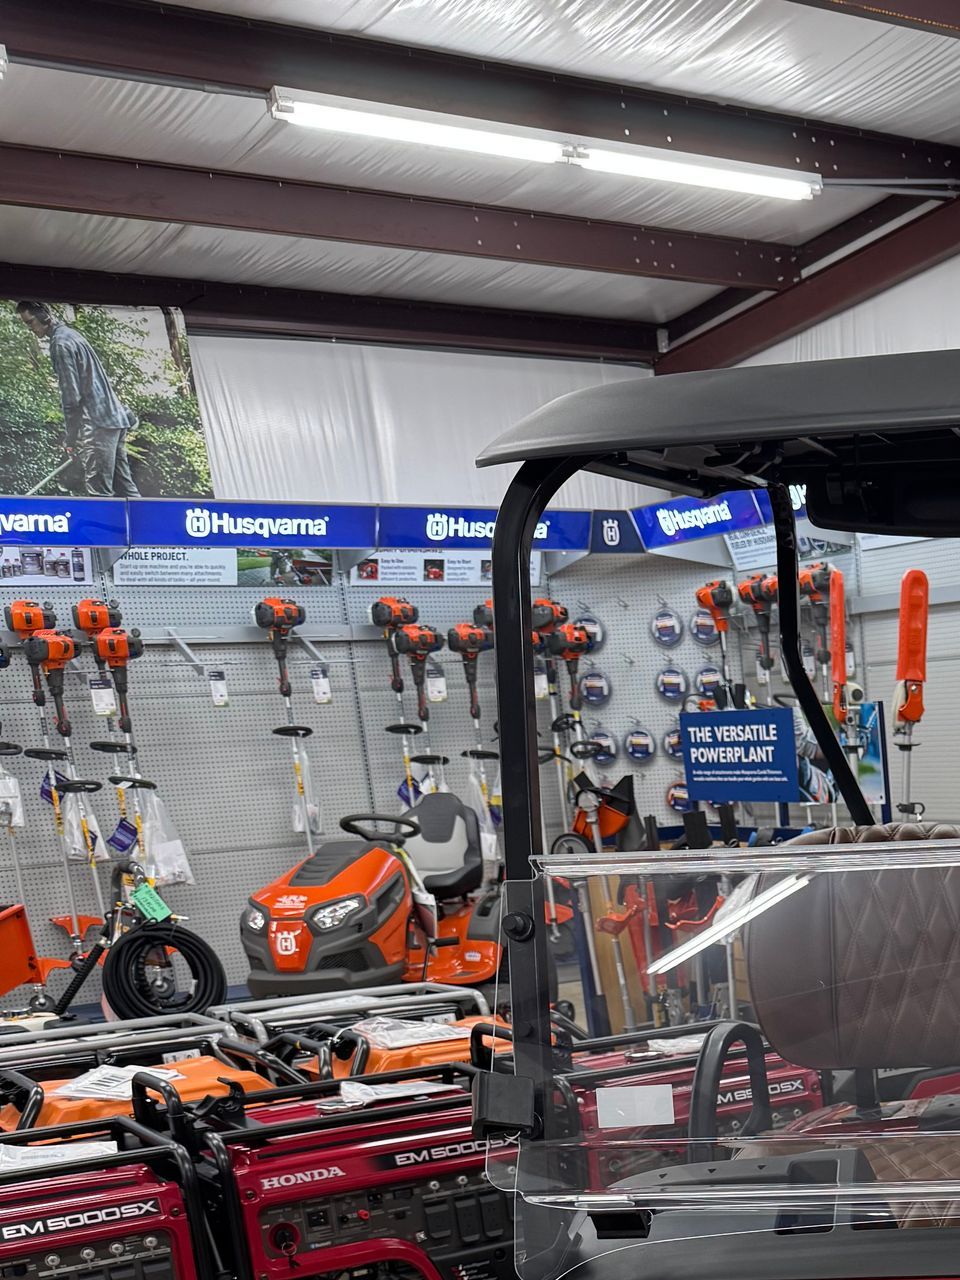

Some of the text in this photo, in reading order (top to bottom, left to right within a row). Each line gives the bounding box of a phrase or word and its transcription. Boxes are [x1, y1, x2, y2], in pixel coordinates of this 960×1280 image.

[0, 513, 69, 534] varna
[211, 512, 327, 538] Husqvarna
[668, 503, 733, 531] Husqvarna
[151, 551, 189, 561] PROJECT.
[687, 724, 778, 743] THE VERSATILE
[690, 746, 775, 763] POWERPLANT
[260, 1166, 346, 1190] HONDA
